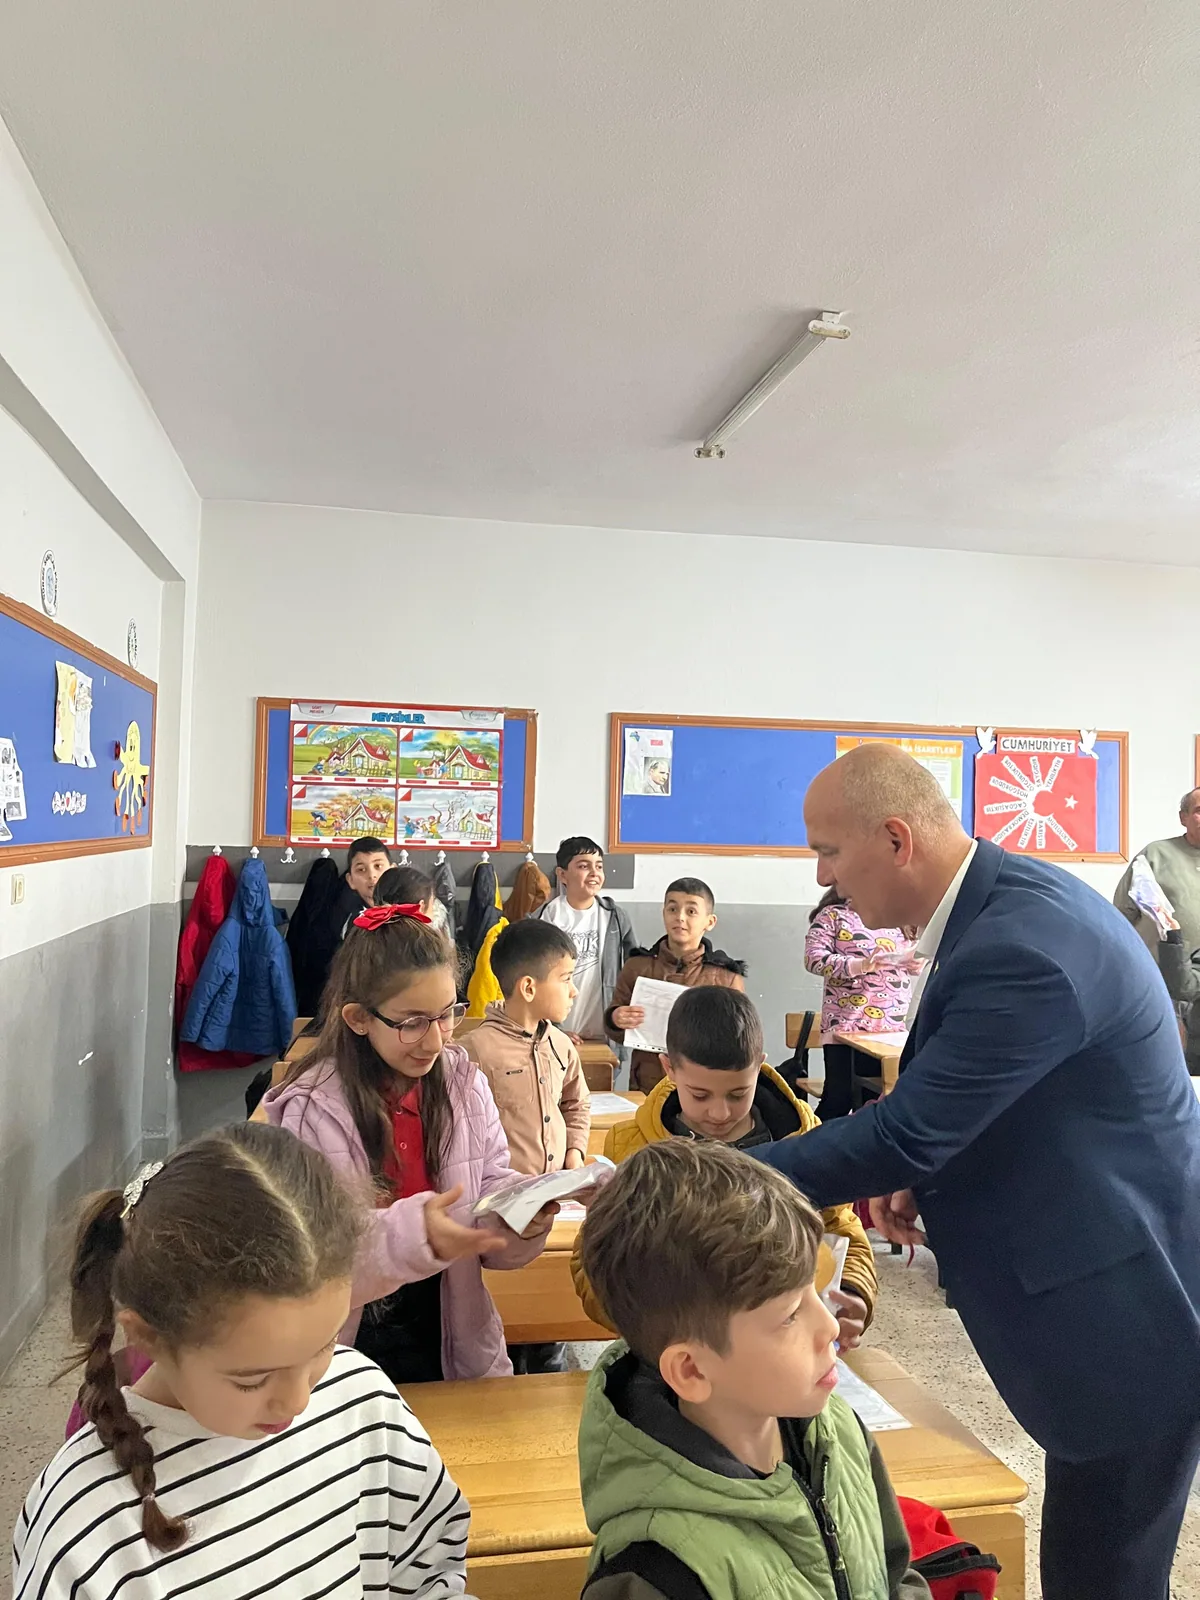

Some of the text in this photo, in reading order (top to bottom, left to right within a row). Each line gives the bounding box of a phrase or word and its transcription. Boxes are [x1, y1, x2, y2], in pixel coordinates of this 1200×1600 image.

[372, 711, 426, 725] MEVSİMLER
[1002, 738, 1072, 753] CUMHURİYET
[573, 937, 599, 953] NIK
